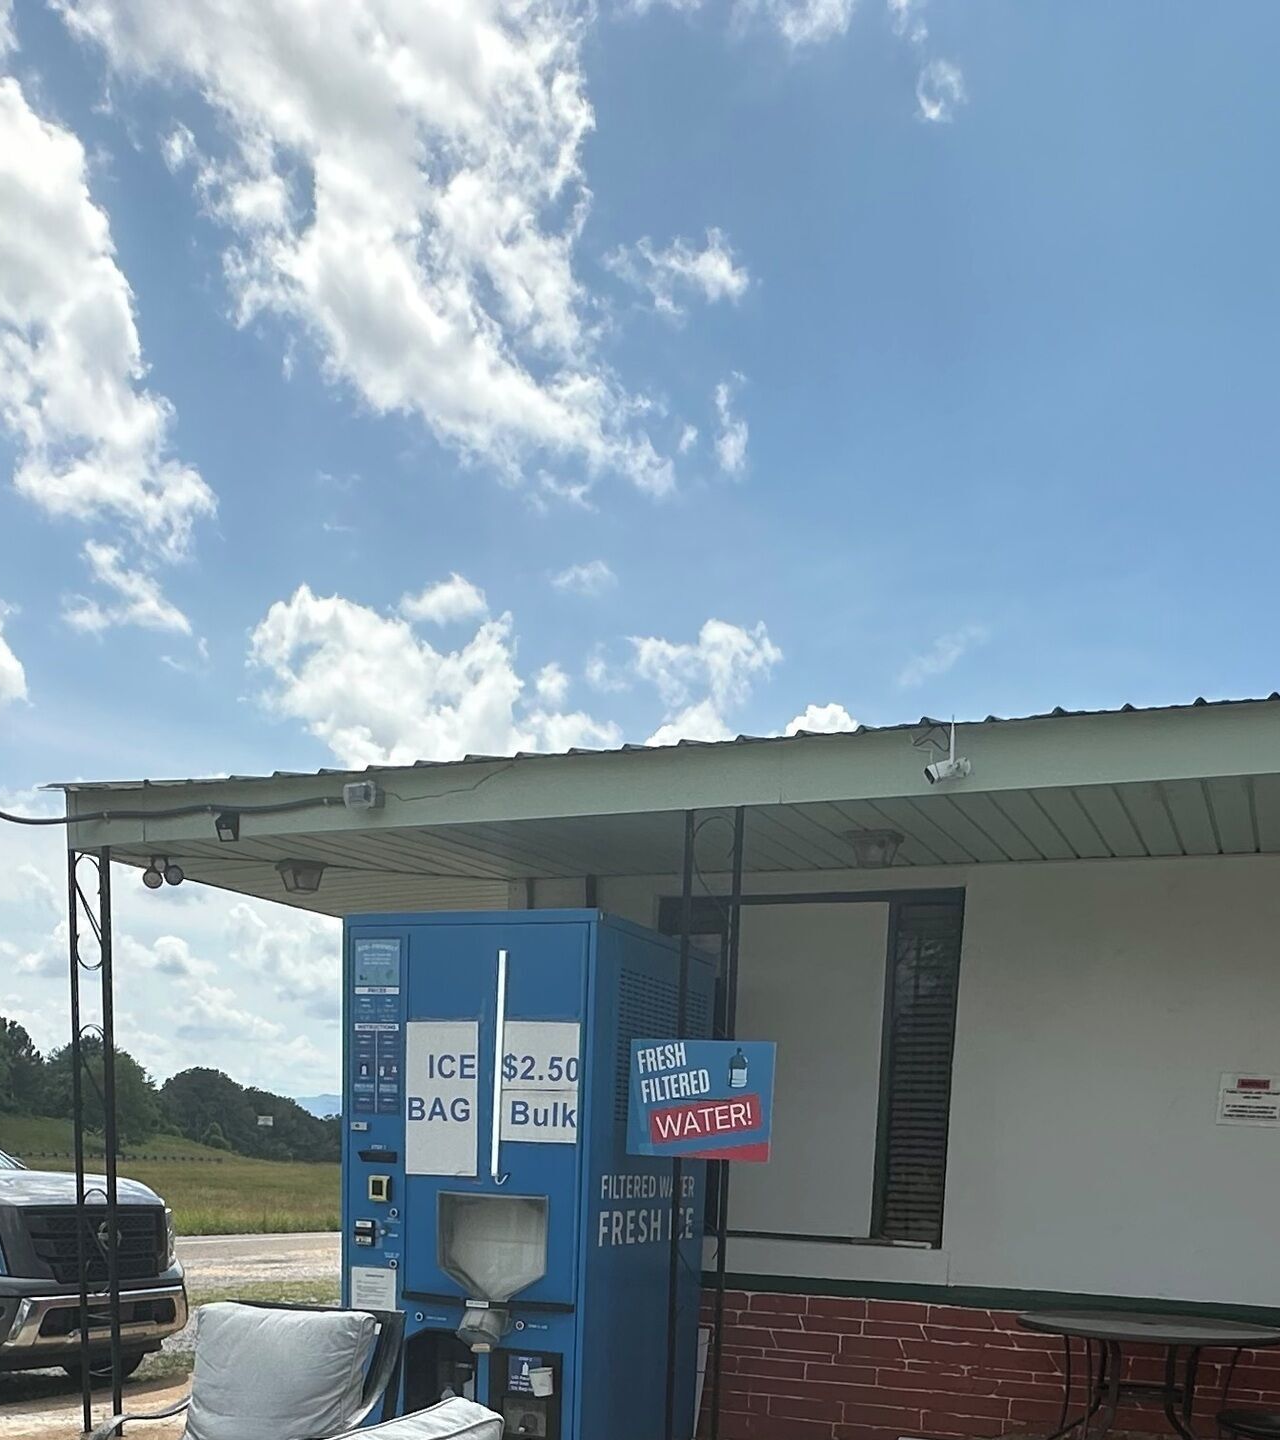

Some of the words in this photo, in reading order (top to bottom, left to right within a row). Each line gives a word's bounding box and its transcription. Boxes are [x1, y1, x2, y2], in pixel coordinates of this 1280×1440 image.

[428, 1054, 476, 1079] ICE
[503, 1053, 579, 1082] $2.50
[637, 1042, 687, 1074] FRESH
[640, 1068, 710, 1104] FILTERED
[407, 1096, 470, 1122] BAG
[511, 1100, 576, 1128] Bulk
[655, 1101, 752, 1139] WATER!
[600, 1175, 656, 1200] FILTERED
[598, 1208, 662, 1247] FRESH
